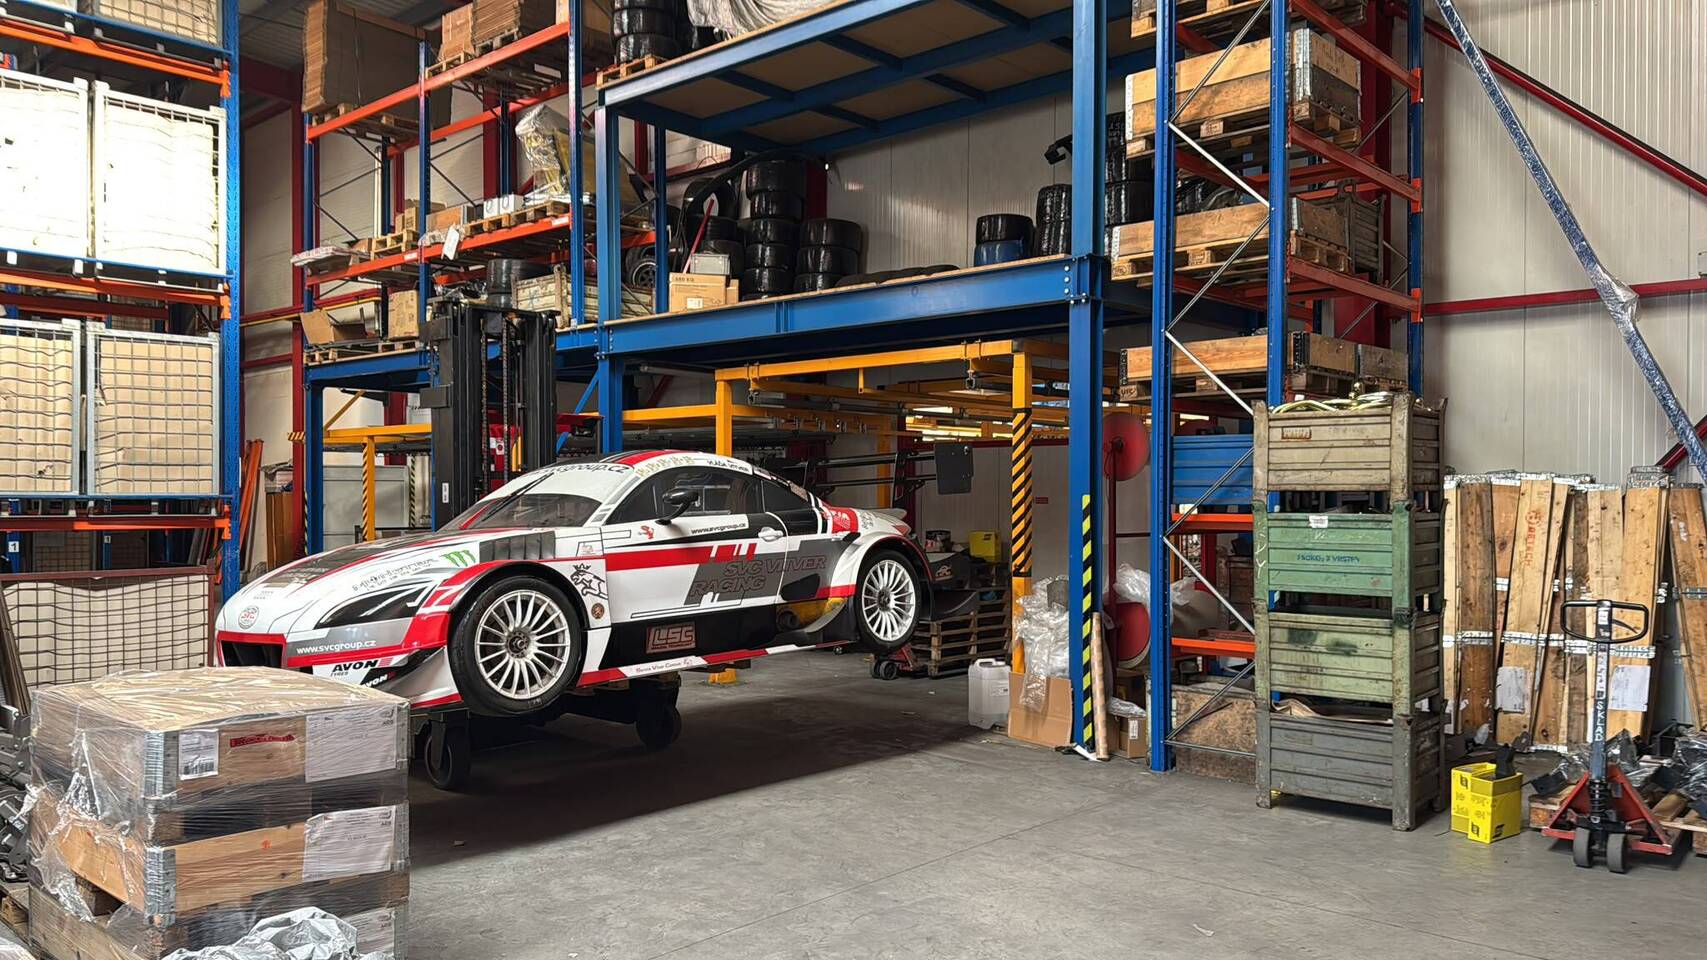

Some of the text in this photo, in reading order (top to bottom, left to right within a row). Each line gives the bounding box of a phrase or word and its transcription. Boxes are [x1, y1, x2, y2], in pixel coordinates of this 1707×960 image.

[689, 574, 766, 598] RACING
[296, 640, 377, 654] www.svcgroup.cz
[332, 659, 378, 673] AVON
